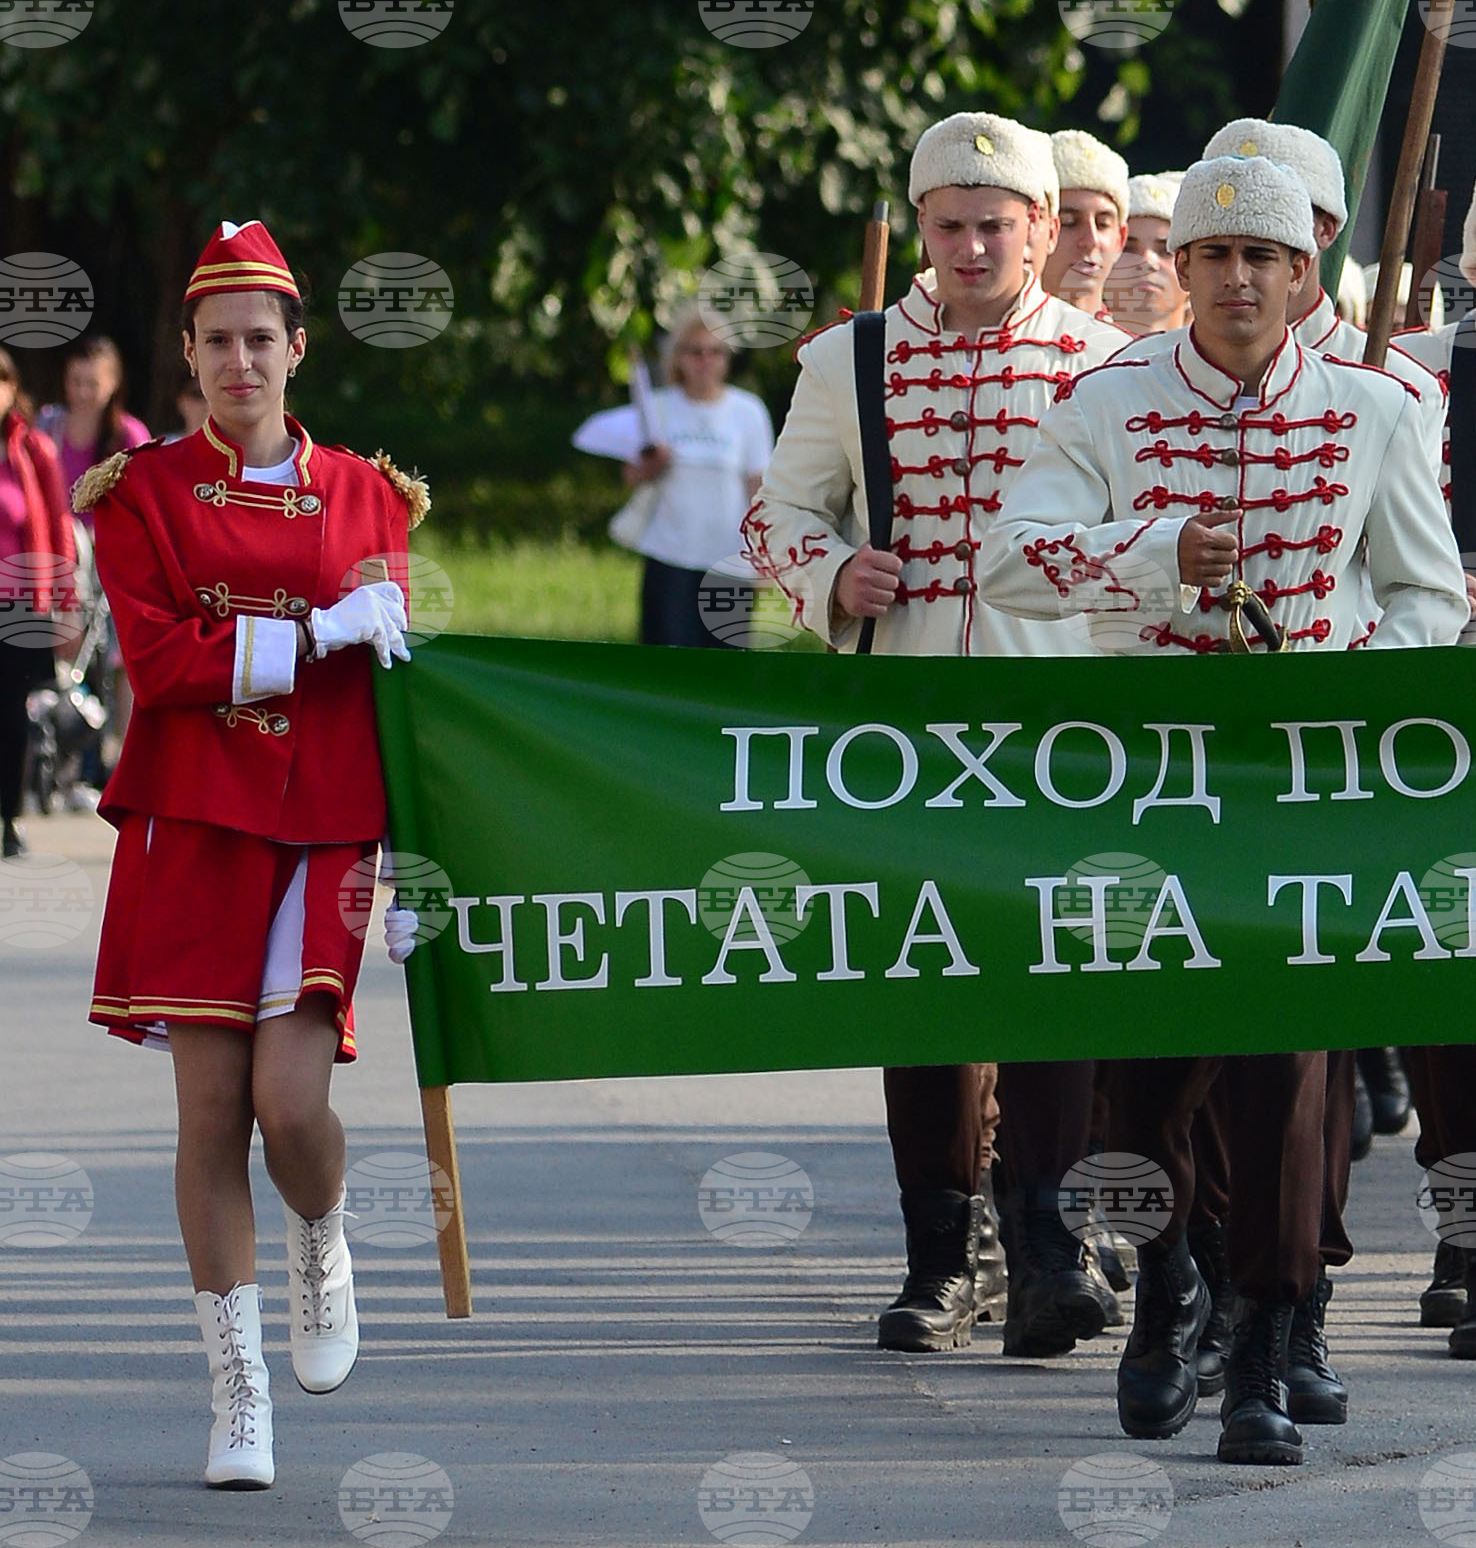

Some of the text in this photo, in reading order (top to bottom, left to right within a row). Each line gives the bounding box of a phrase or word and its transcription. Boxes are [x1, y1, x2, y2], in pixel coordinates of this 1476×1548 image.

[719, 721, 1221, 826] ПОХОД
[1270, 718, 1471, 802] ПО
[447, 880, 980, 992] ЧЕТАТА
[1024, 874, 1222, 974] НА
